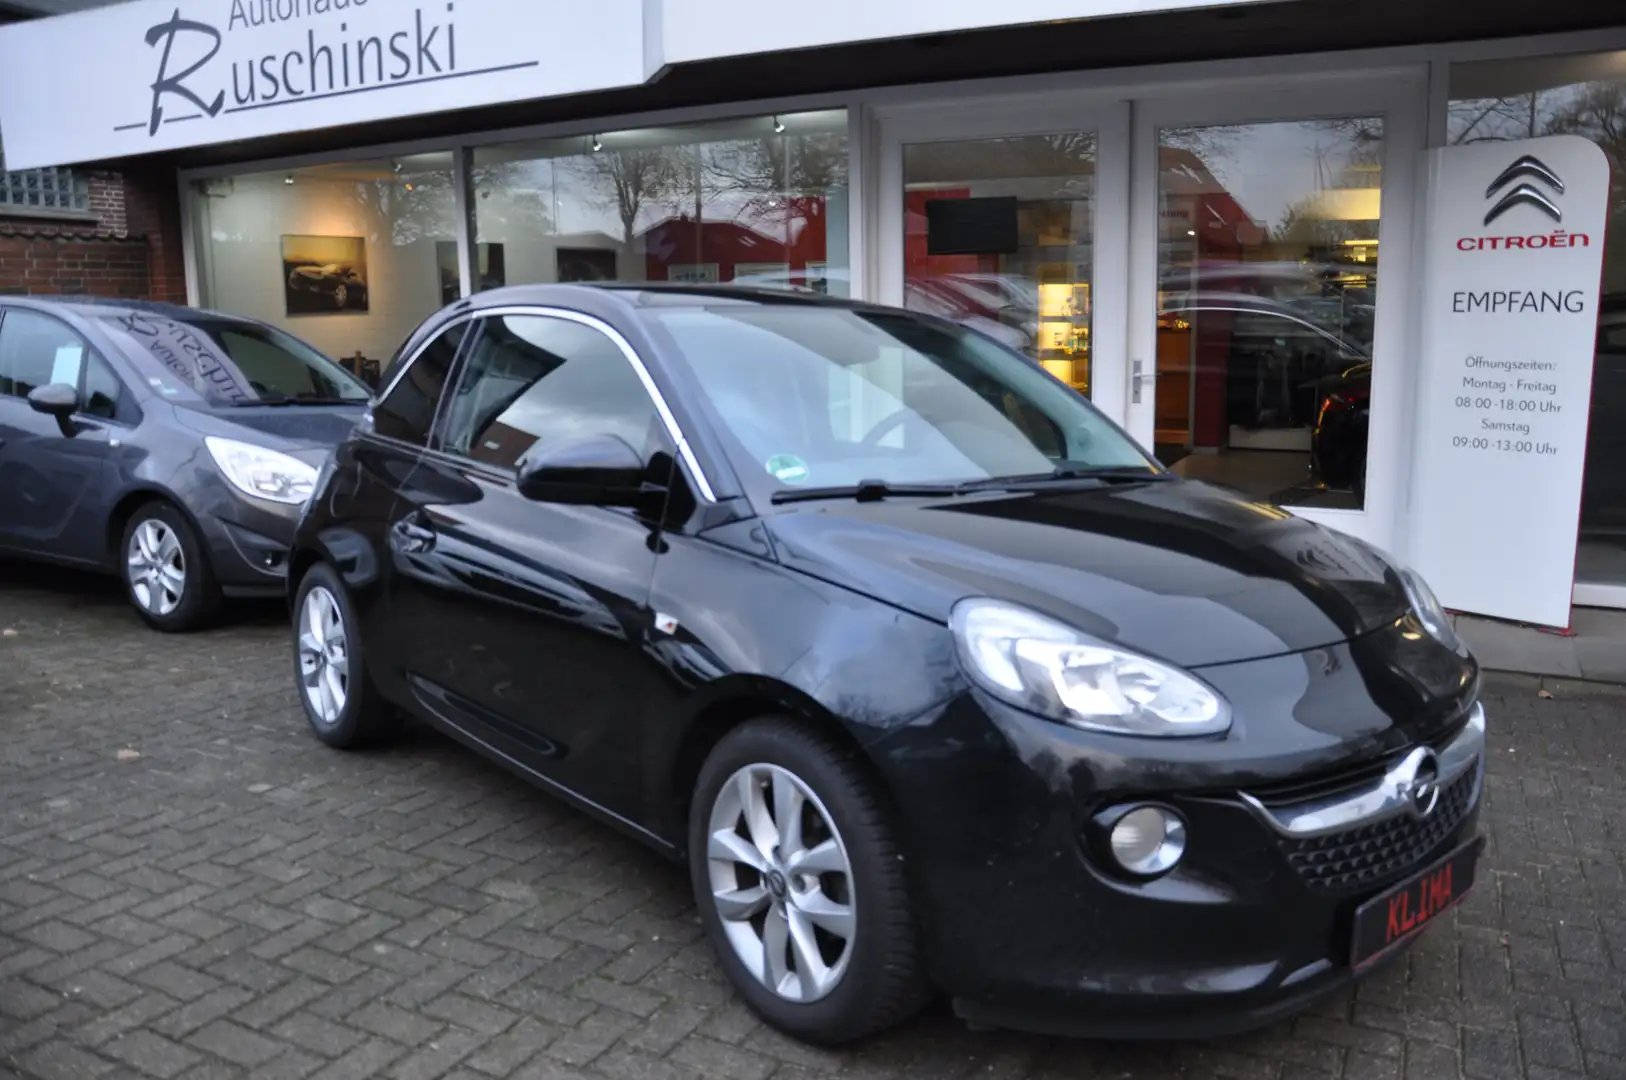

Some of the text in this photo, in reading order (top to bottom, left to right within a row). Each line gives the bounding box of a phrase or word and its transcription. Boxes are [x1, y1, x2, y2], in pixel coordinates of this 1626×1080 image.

[144, 3, 457, 137] Ruschinski
[1452, 290, 1584, 313] EMPFANG
[1463, 377, 1506, 393] Montag
[1517, 379, 1556, 395] Freitag
[1540, 400, 1562, 413] Uhr
[1481, 418, 1530, 436] Samstag
[1536, 442, 1558, 455] Uhr
[1385, 861, 1452, 945] KLIMA
